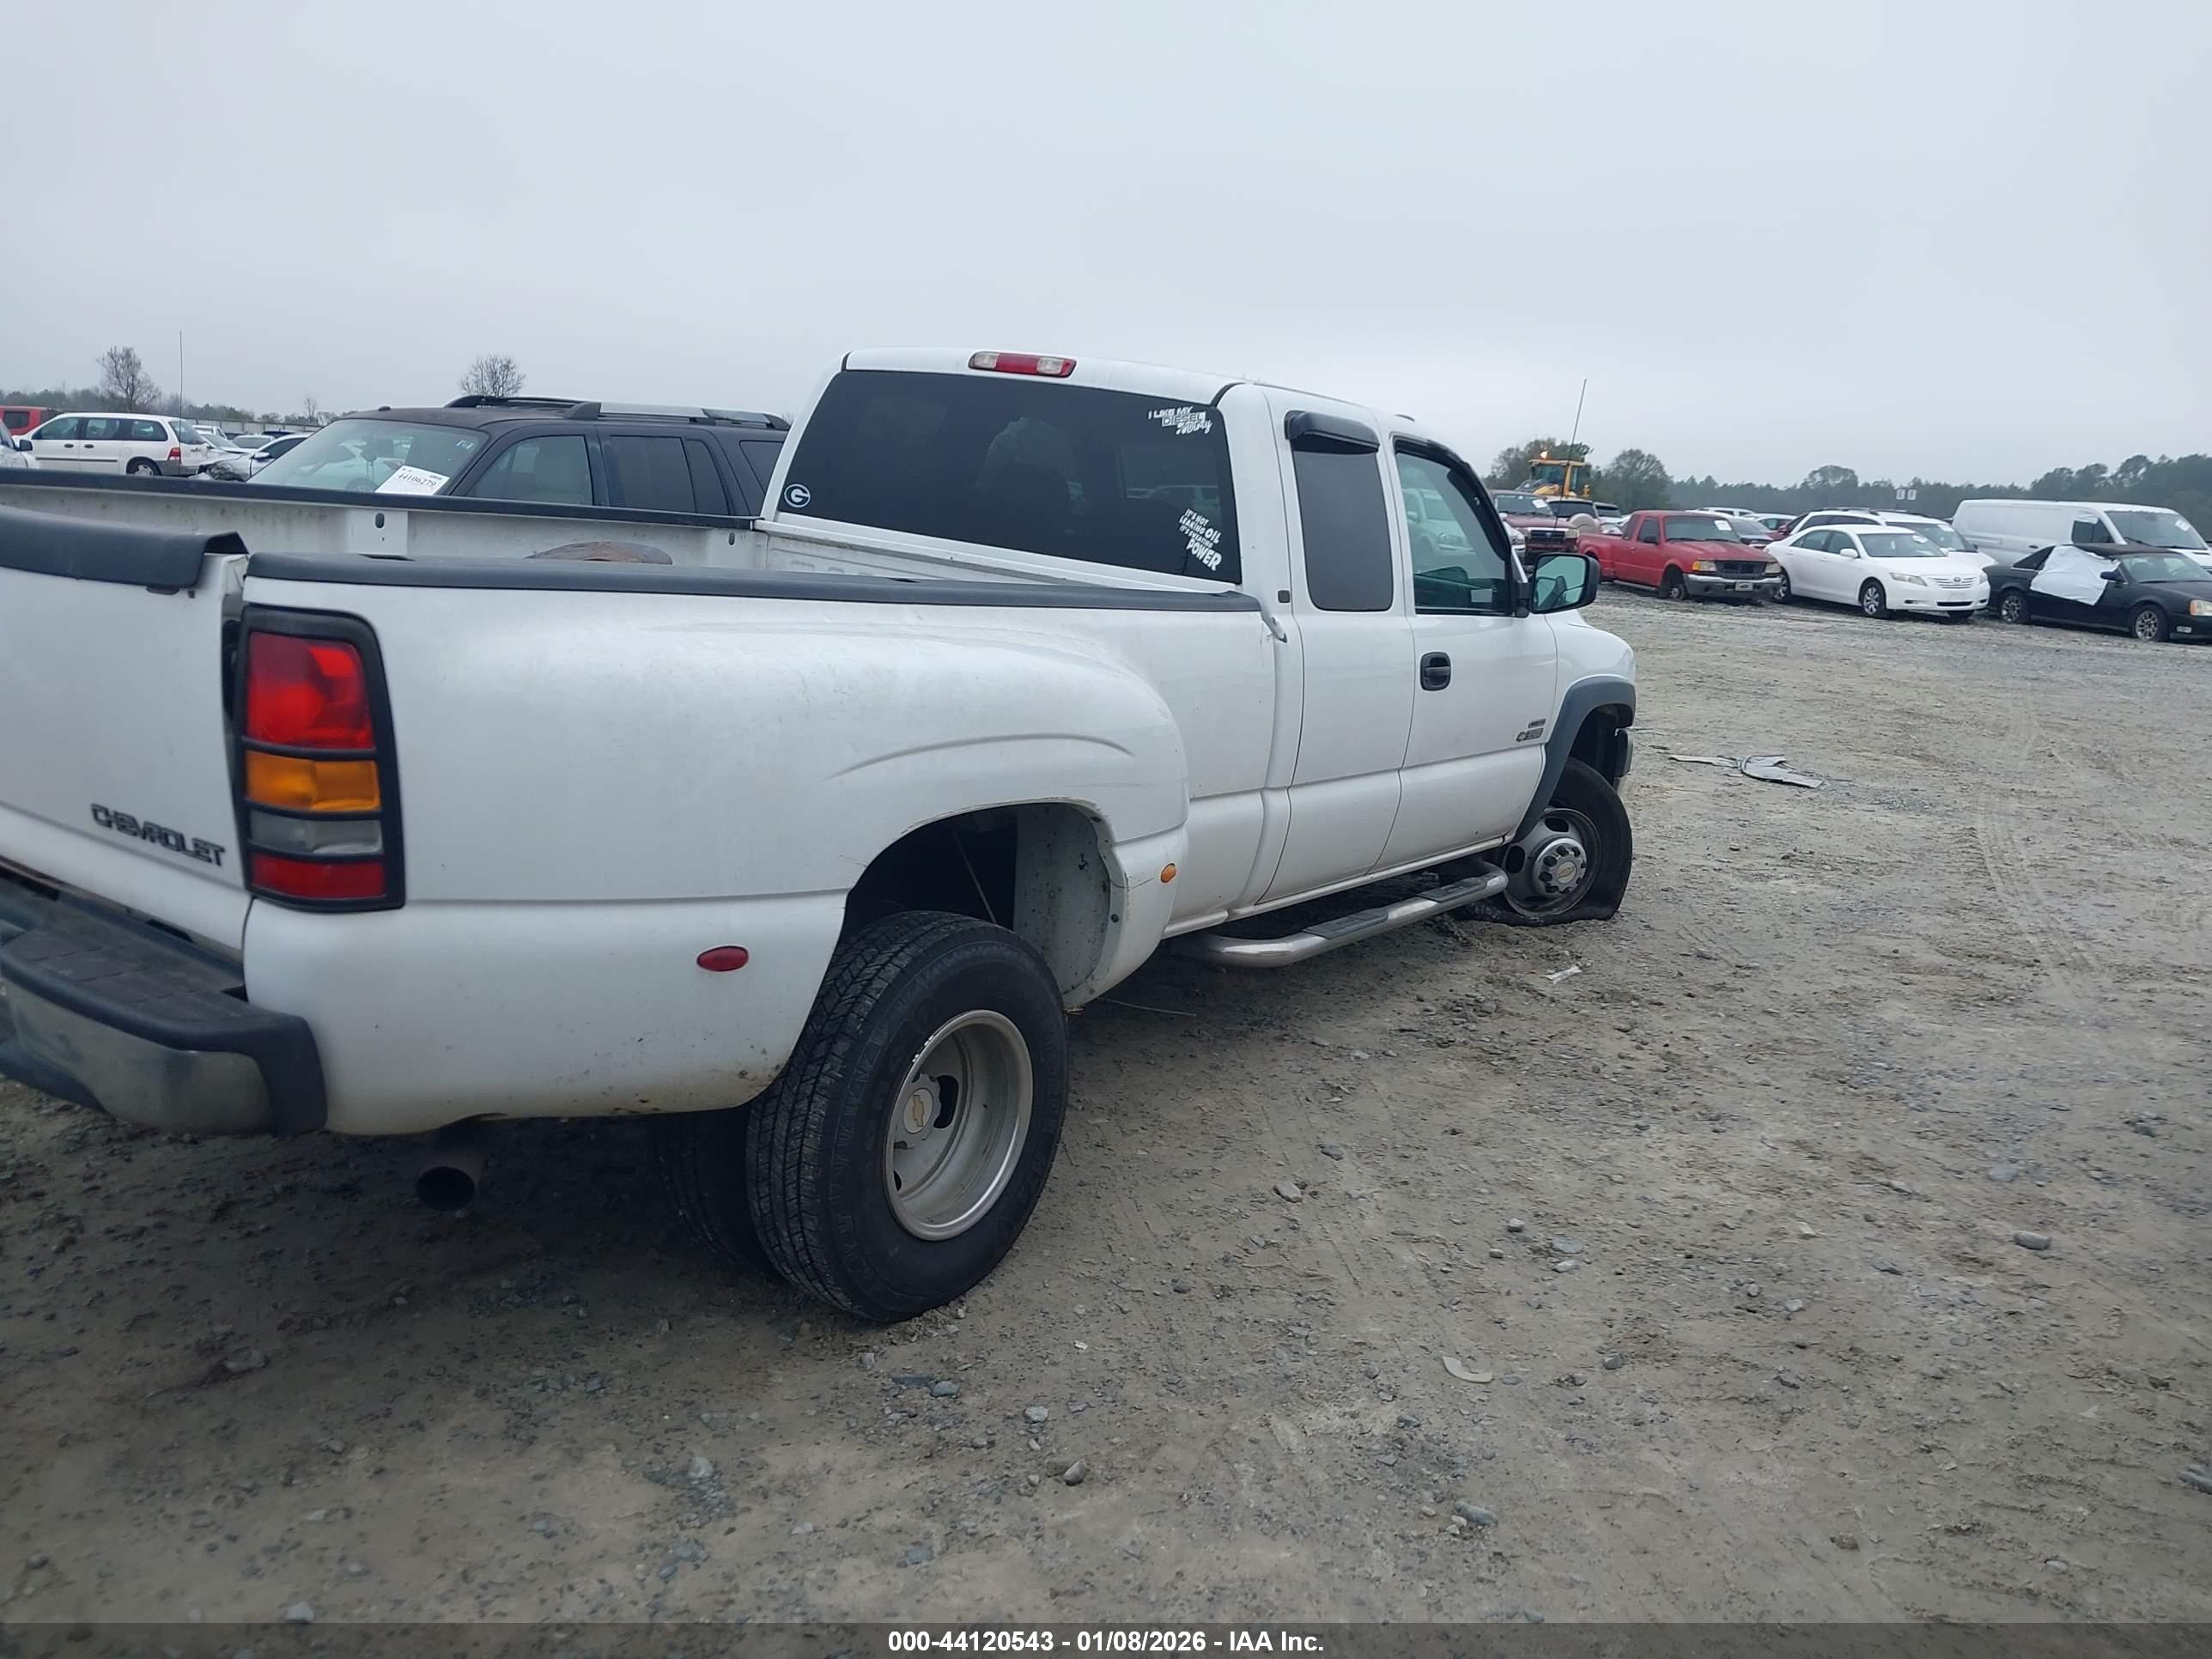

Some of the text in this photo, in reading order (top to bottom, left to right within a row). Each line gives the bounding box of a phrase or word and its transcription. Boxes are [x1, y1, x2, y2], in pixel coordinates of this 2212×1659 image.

[1194, 514, 1209, 526] NOT
[1204, 527, 1221, 544] OIL
[1186, 538, 1222, 571] POWER
[90, 803, 225, 866] CHEVROLET
